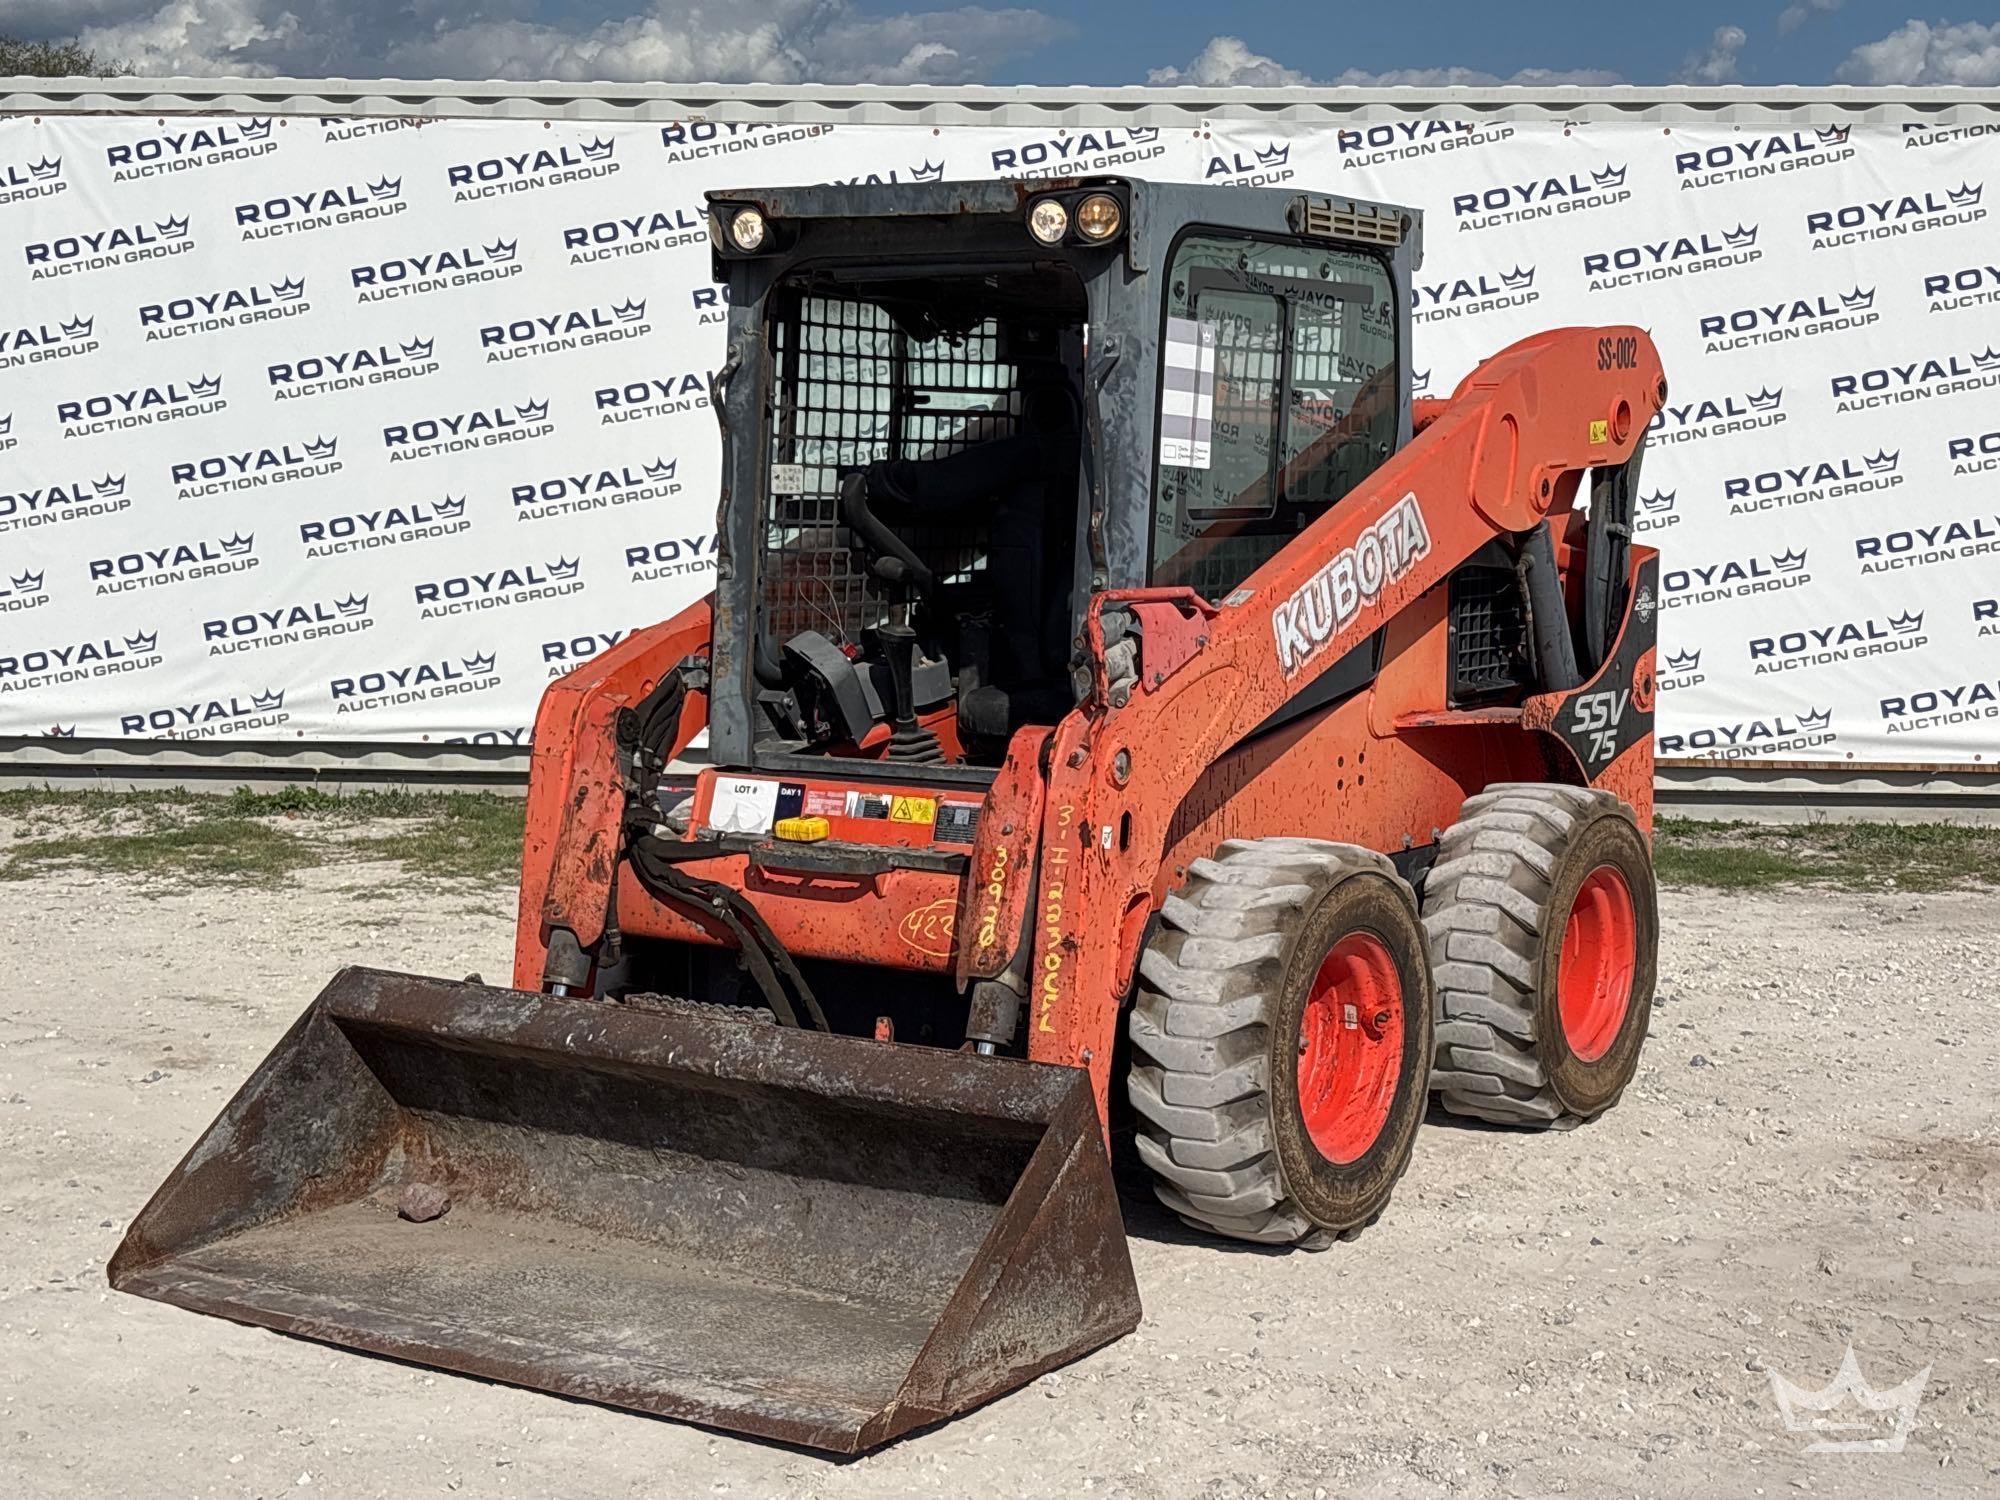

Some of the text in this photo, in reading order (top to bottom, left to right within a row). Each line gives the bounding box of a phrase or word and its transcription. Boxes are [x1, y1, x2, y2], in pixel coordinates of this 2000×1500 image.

[107, 127, 239, 166] ROYAL
[325, 119, 415, 143] AUCTION
[668, 124, 834, 163] AUCTION GROUP
[1343, 128, 1515, 170] AUCTION GROUP
[114, 143, 277, 182] AUCTION GROUP
[448, 147, 581, 186] ROYAL
[992, 131, 1126, 170] ROYAL
[1094, 146, 1164, 168] GROUP
[1676, 133, 1815, 174] ROYAL
[1681, 149, 1854, 190] AUCTION GROUP
[455, 163, 619, 202] AUCTION GROUP
[1454, 175, 1591, 216] ROYAL
[235, 186, 368, 225] ROYAL
[243, 203, 406, 241] AUCTION GROUP
[1460, 191, 1630, 231] AUCTION GROUP
[1807, 193, 1946, 234] ROYAL
[26, 226, 156, 264] ROYAL
[564, 210, 697, 249] ROYAL
[1813, 209, 1986, 250] AUCTION GROUP
[33, 241, 194, 280] AUCTION GROUP
[351, 249, 484, 287] ROYAL
[571, 240, 660, 265] AUCTION
[1584, 235, 1722, 275] ROYAL
[1590, 251, 1762, 291] AUCTION GROUP
[359, 265, 522, 303] AUCTION GROUP
[140, 287, 271, 326] ROYAL
[146, 303, 310, 341] AUCTION GROUP
[1466, 292, 1540, 315] GROUP
[1701, 297, 1839, 337] ROYAL
[480, 309, 612, 347] ROYAL
[487, 325, 651, 363] AUCTION GROUP
[1706, 313, 1879, 353] AUCTION GROUP
[30, 342, 99, 363] GROUP
[268, 347, 400, 385] ROYAL
[1598, 337, 1637, 371] SS-002
[275, 363, 439, 400] AUCTION GROUP
[1832, 357, 1971, 397] ROYAL
[58, 385, 188, 423] ROYAL
[65, 401, 226, 438] AUCTION GROUP
[601, 400, 691, 425] AUCTION
[1837, 388, 1931, 413] AUCTION
[384, 409, 515, 446] ROYAL
[391, 425, 554, 462] AUCTION GROUP
[1712, 414, 1787, 435] GROUP
[172, 446, 304, 484] ROYAL
[179, 462, 342, 499] AUCTION GROUP
[1725, 460, 1863, 499] ROYAL
[512, 468, 643, 506] ROYAL
[519, 484, 681, 521] AUCTION GROUP
[1731, 476, 1903, 514] AUCTION GROUP
[62, 499, 131, 520] GROUP
[300, 505, 432, 543] ROYAL
[307, 521, 470, 558] AUCTION GROUP
[1856, 519, 1995, 558] ROYAL
[90, 542, 220, 580] ROYAL
[97, 558, 258, 595] AUCTION GROUP
[1862, 550, 1955, 574] AUCTION
[415, 567, 546, 604] ROYAL
[422, 582, 584, 619] AUCTION GROUP
[1275, 499, 1427, 670] KUBOTA
[1737, 575, 1811, 596] GROUP
[204, 603, 335, 641] ROYAL
[210, 619, 373, 656] AUCTION GROUP
[1750, 621, 1888, 659] ROYAL
[2, 656, 162, 692] AUCTION GROUP
[1755, 637, 1927, 674] AUCTION GROUP
[331, 662, 462, 699] ROYAL
[338, 677, 500, 713] AUCTION GROUP
[1881, 681, 2000, 718] ROYA
[121, 698, 251, 734] ROYAL
[220, 714, 289, 733] GROUP
[1571, 688, 1629, 734] SSV
[1888, 710, 1979, 732] AUCTION
[1588, 729, 1617, 763] 75
[1659, 718, 1798, 754] ROYAL
[1762, 734, 1837, 754] GROUP
[735, 784, 751, 794] LOT
[781, 788, 796, 796] DAY
